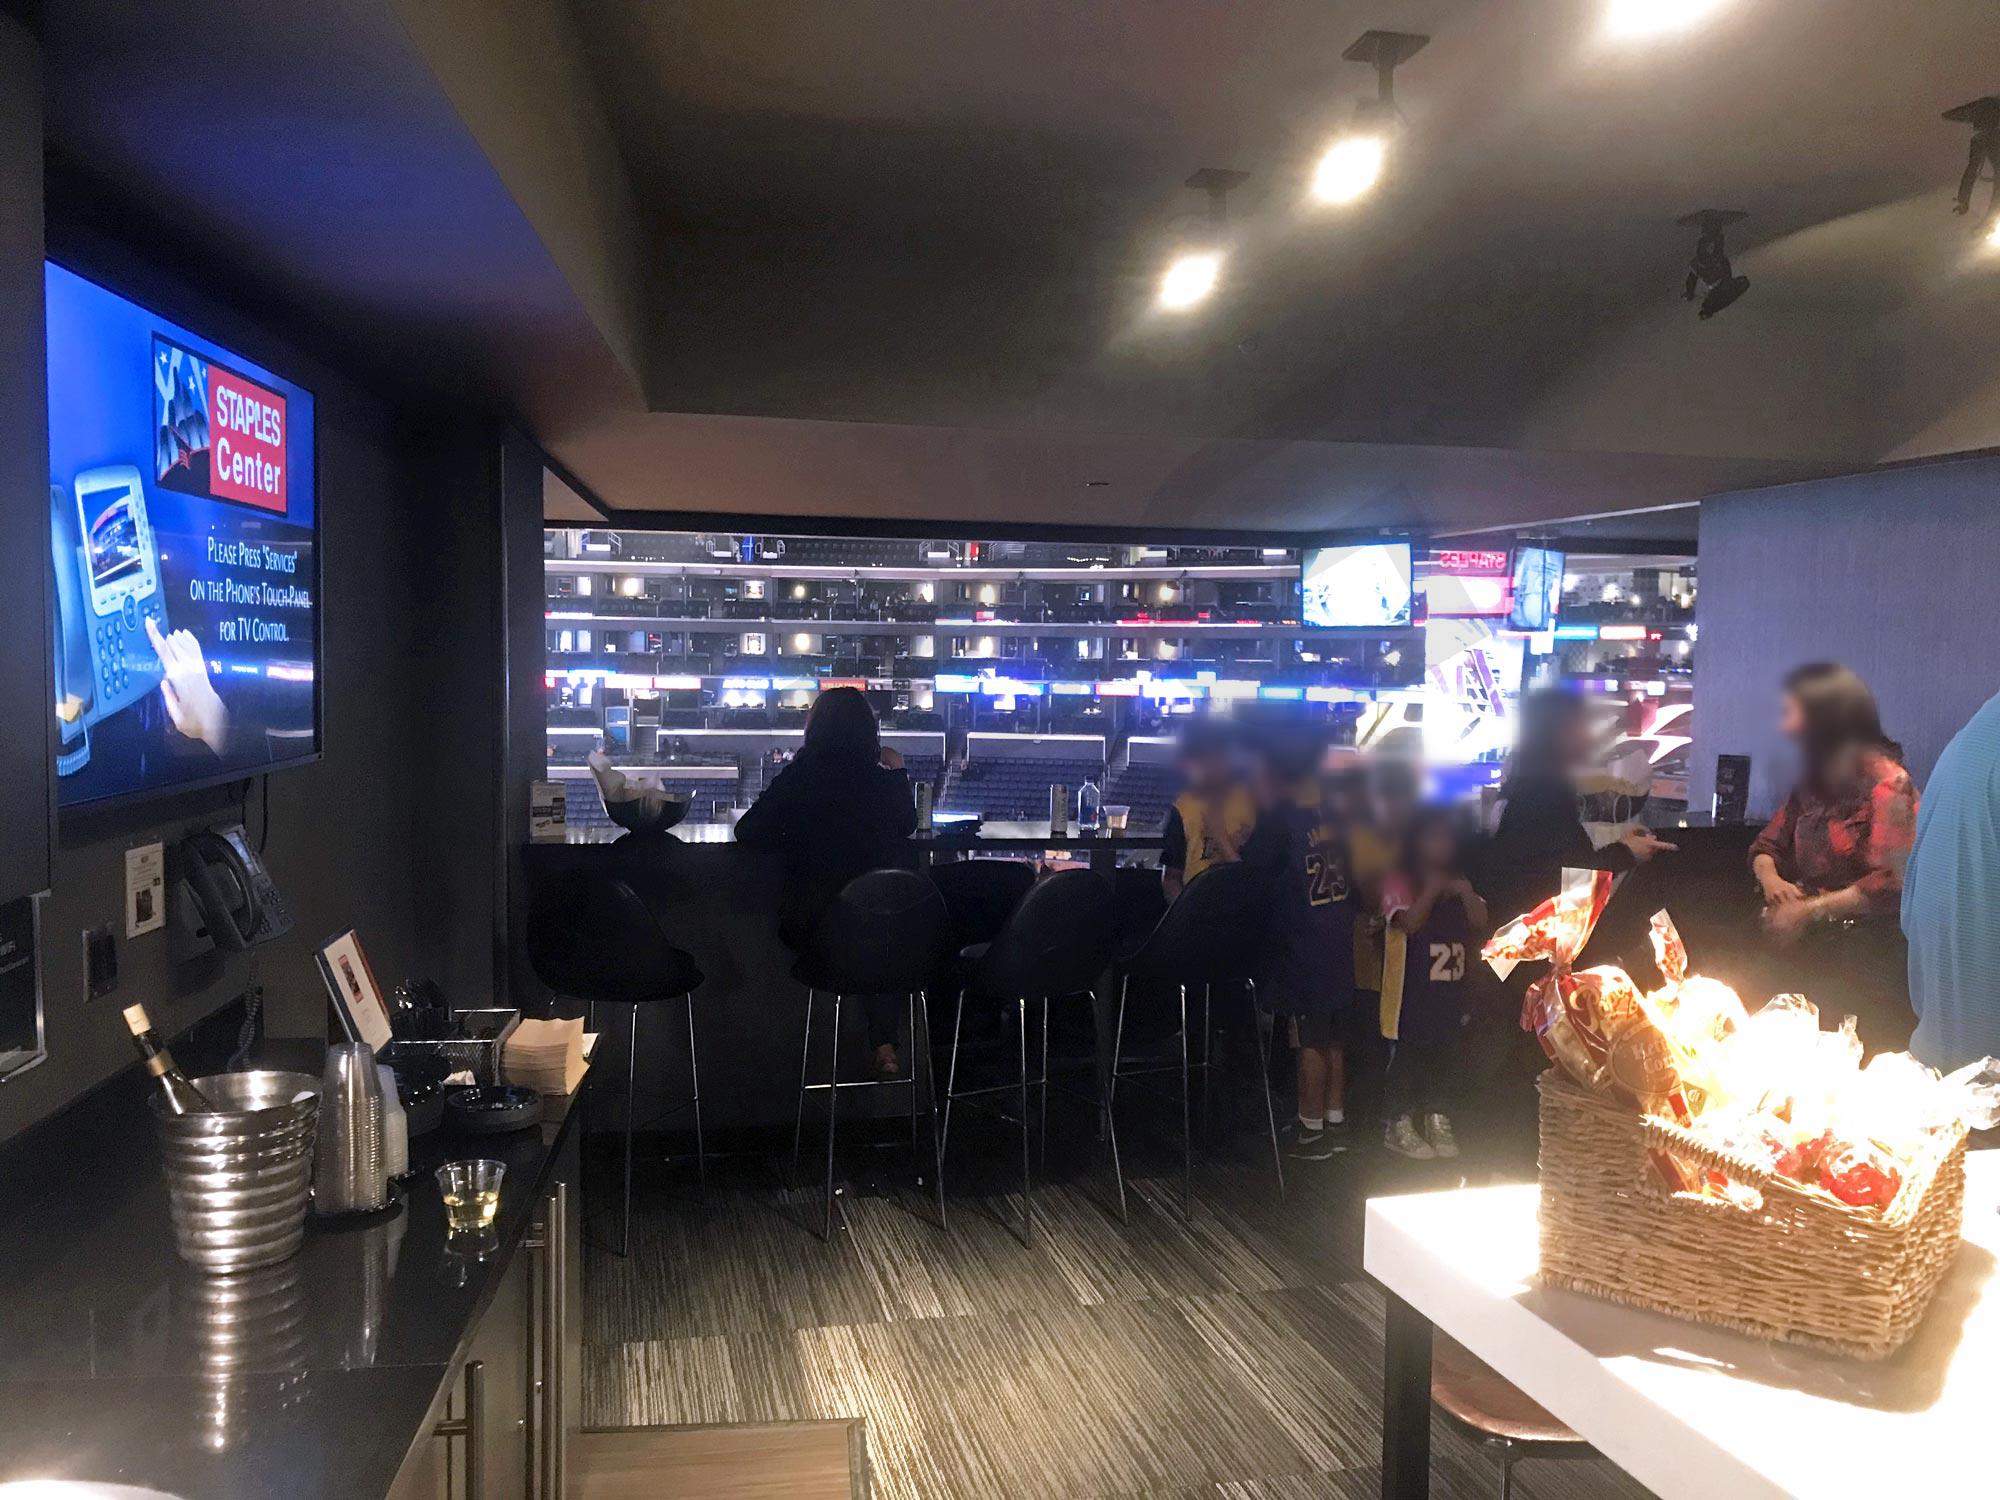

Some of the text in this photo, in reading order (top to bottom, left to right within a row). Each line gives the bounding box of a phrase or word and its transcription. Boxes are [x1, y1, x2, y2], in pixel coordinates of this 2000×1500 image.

[216, 385, 281, 447] STAPLES
[217, 437, 281, 495] Center
[238, 617, 251, 641] TV
[1429, 942, 1466, 981] 23
